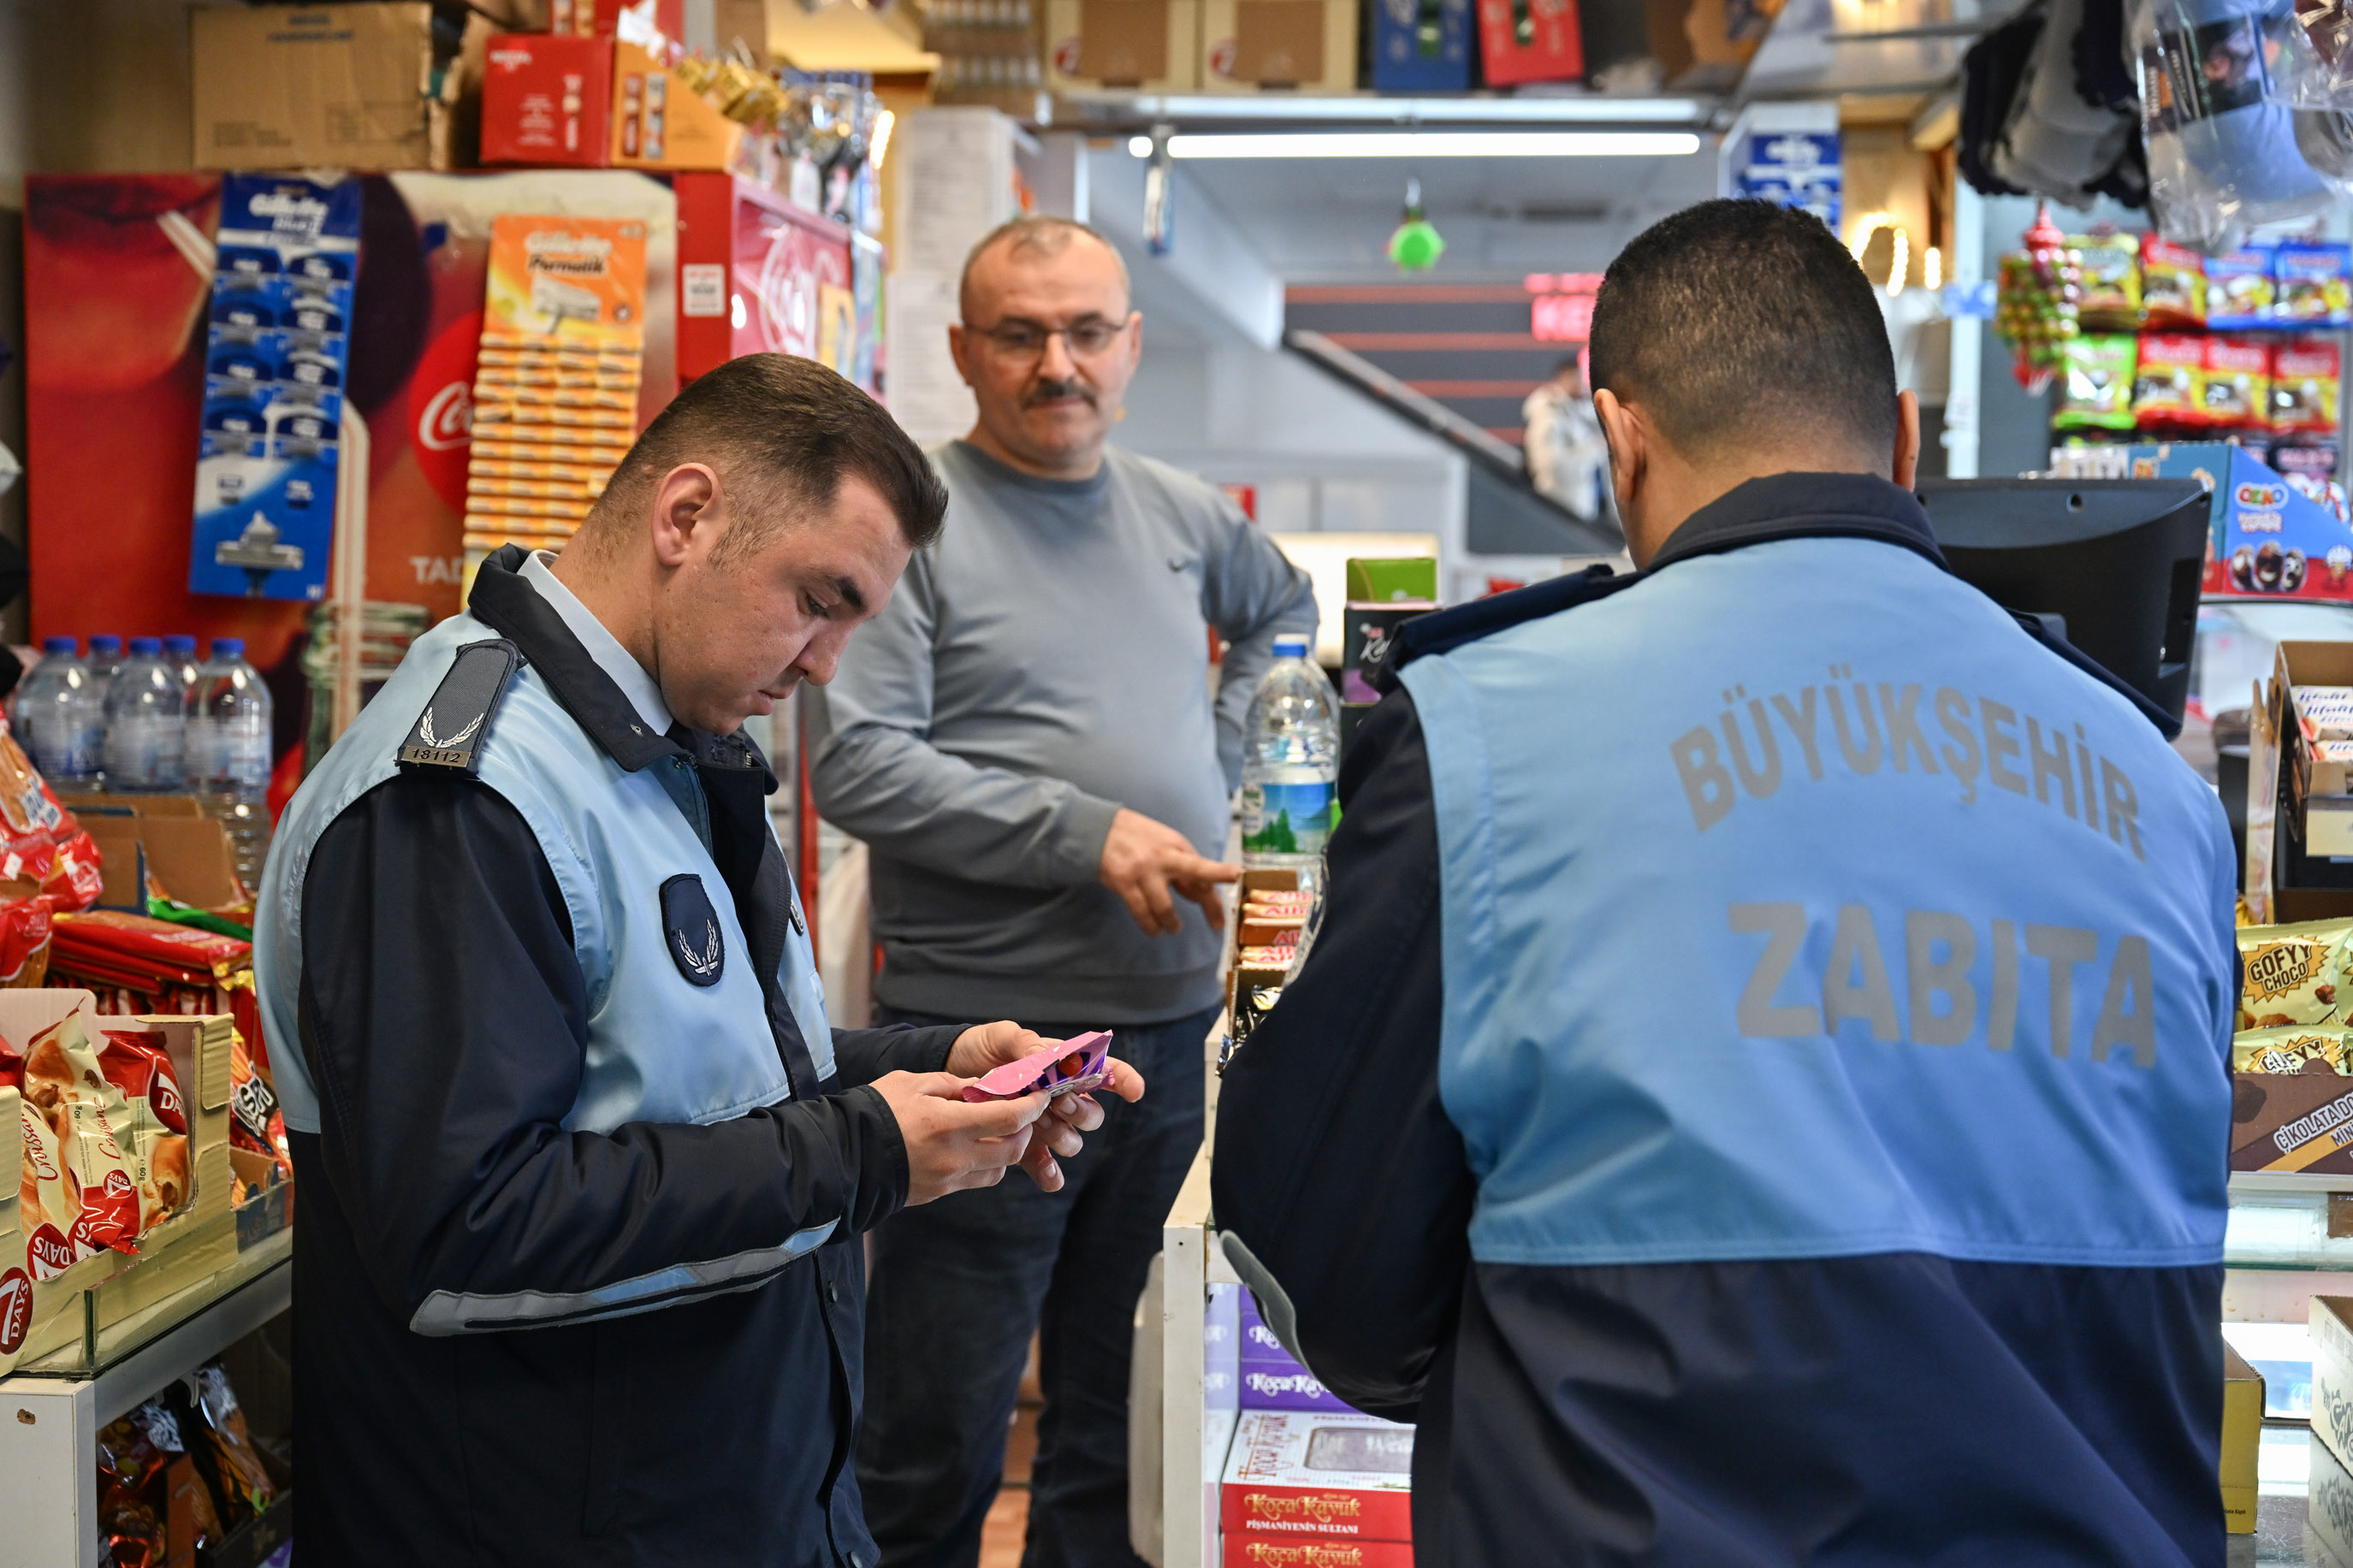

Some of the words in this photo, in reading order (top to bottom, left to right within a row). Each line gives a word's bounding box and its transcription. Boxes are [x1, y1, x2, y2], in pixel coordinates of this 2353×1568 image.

[412, 748, 460, 763] 18112
[1669, 663, 2146, 866] BÜYÜKŞEHİR
[2251, 944, 2311, 980] GOFYY
[2263, 962, 2308, 992] CHOCO
[1727, 901, 2158, 1069] ZABITA
[2276, 1107, 2342, 1153] ÇİKOLATA
[108, 1172, 128, 1186] DAYS
[33, 1236, 70, 1265] DAYS
[10, 1280, 29, 1338] DAYS
[1246, 1373, 1291, 1397] Koca
[1244, 1493, 1295, 1521] Koca
[1295, 1495, 1361, 1524] Kavuk
[1246, 1519, 1317, 1532] PİŞMANİYENİN
[1318, 1524, 1359, 1535] SULTANI
[1246, 1542, 1298, 1568] Koca
[1297, 1545, 1362, 1568] Kavuk
